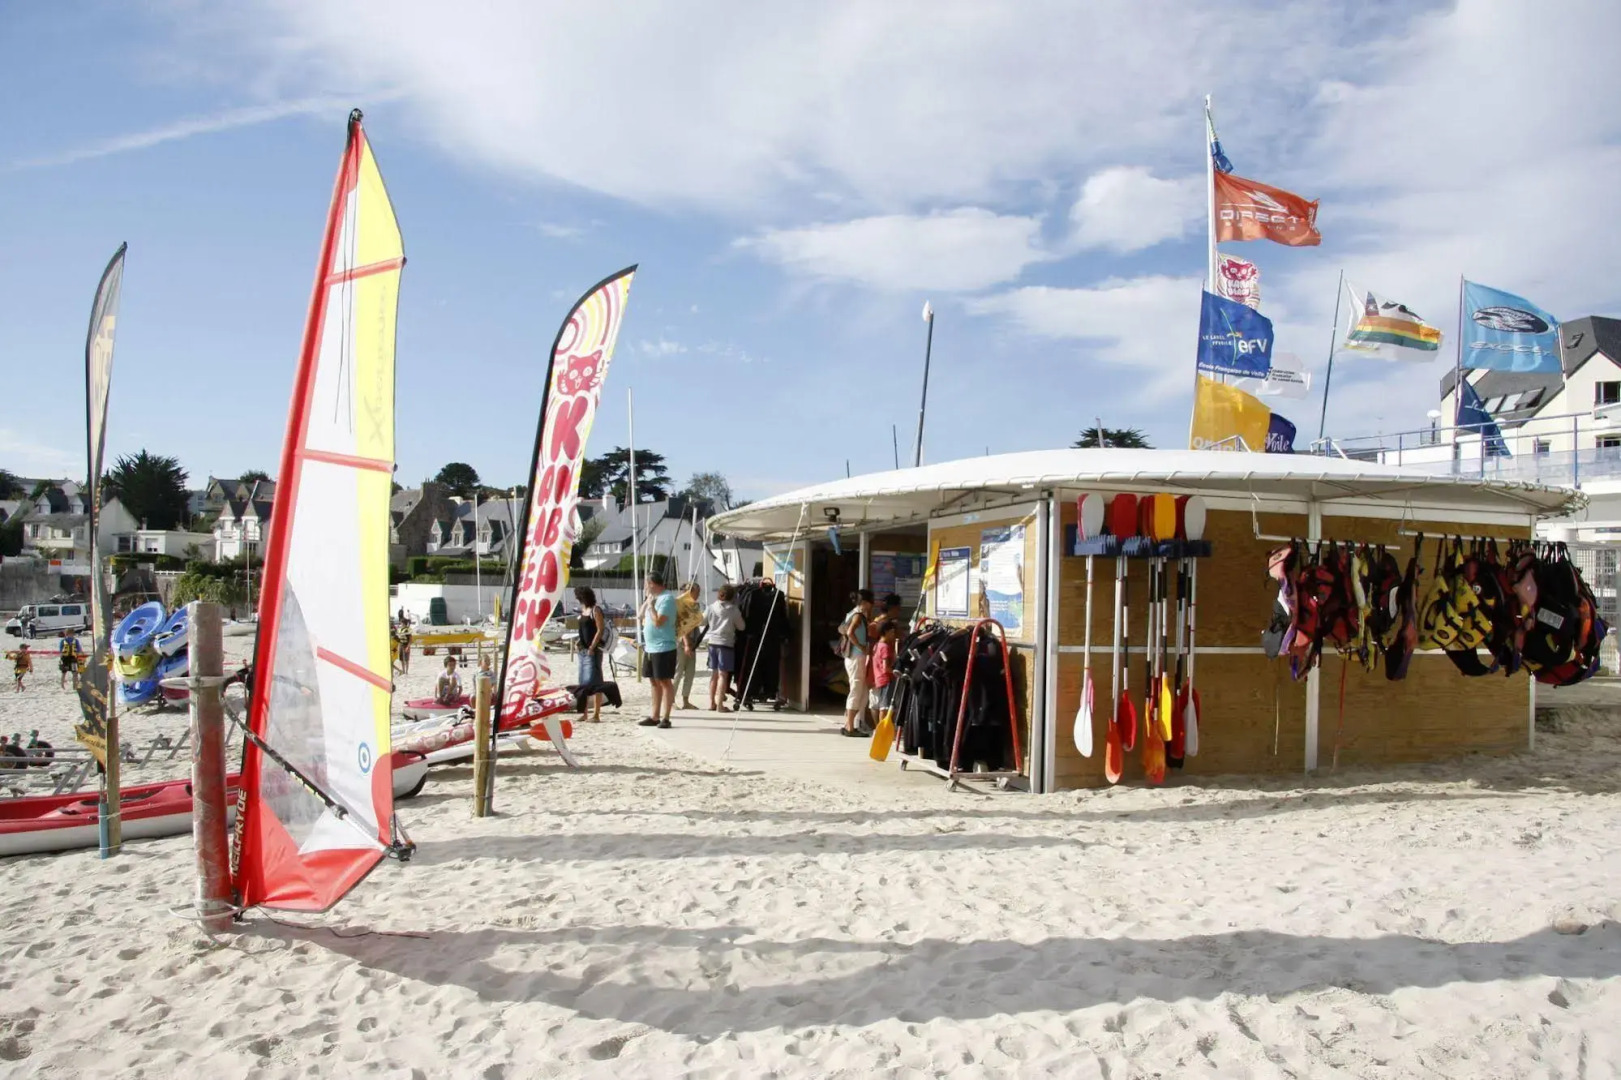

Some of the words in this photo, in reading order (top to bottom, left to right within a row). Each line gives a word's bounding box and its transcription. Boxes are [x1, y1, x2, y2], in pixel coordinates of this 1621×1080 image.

[1220, 209, 1299, 224] DIRECT
[1265, 432, 1290, 452] Voile
[231, 787, 247, 876] NEILPRYDE
